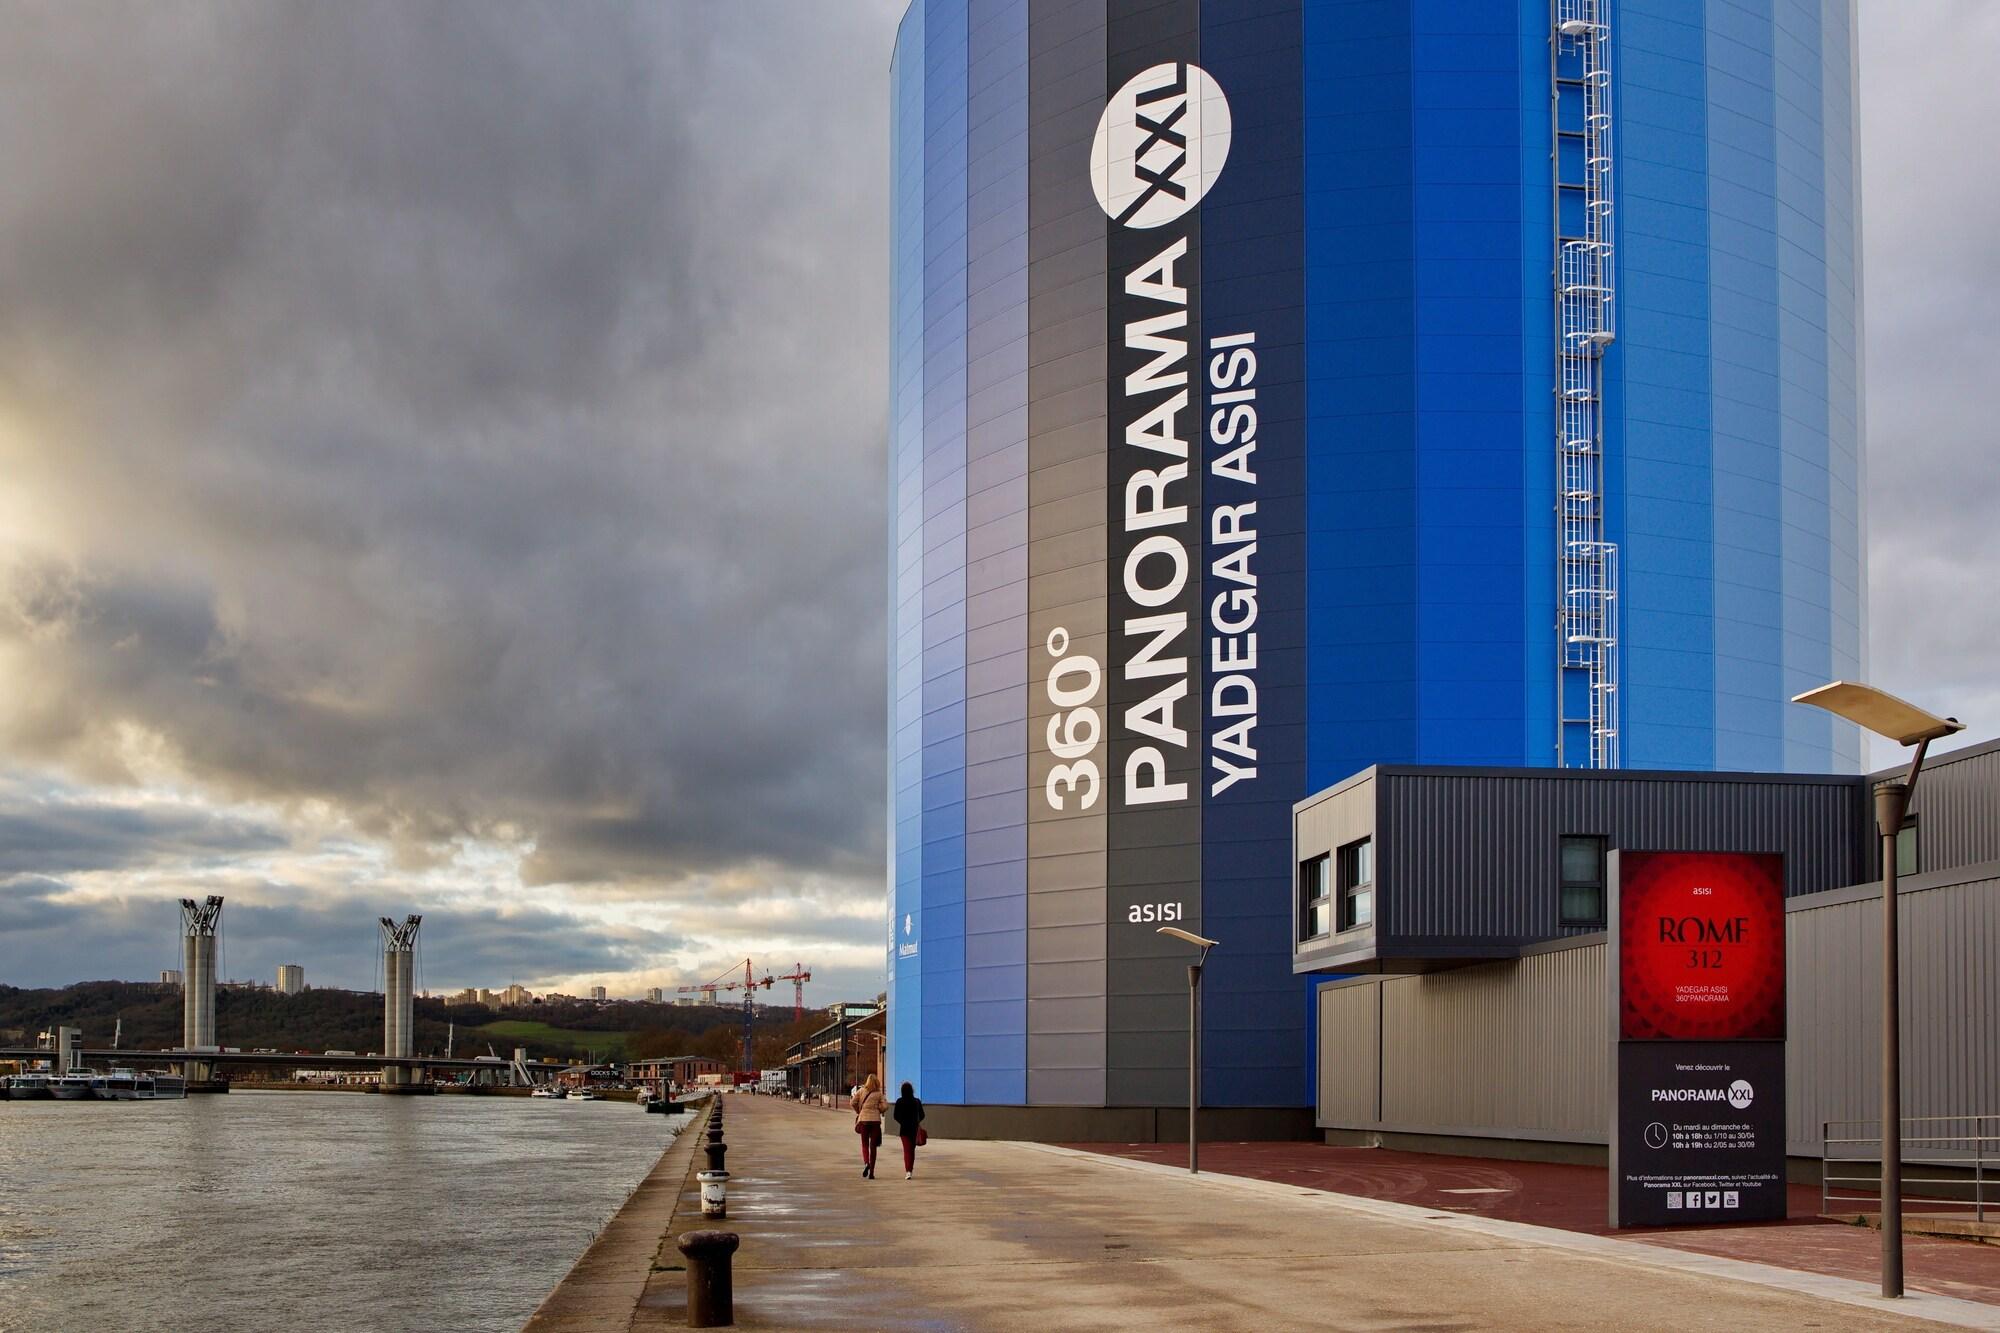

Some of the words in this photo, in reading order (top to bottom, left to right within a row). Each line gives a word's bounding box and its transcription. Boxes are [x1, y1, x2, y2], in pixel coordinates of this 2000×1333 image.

[1209, 332, 1257, 484] ASISI
[1124, 236, 1189, 806] PANORAMA
[1211, 501, 1257, 797] YADEGAR
[1046, 627, 1100, 810] 360°
[1129, 902, 1182, 922] asisi
[1687, 950, 1723, 968] 312
[1675, 985, 1709, 994] YADEGAR
[1710, 985, 1728, 994] ASISI
[1675, 1063, 1694, 1071] Venez
[1695, 1063, 1723, 1071] découvrir
[1724, 1063, 1730, 1071] le
[1651, 1089, 1727, 1101] PANORAMA
[1673, 1123, 1682, 1131] Du
[1683, 1123, 1701, 1131] mardi
[1711, 1123, 1740, 1131] dimanche
[1672, 1132, 1684, 1140] 10h
[1691, 1132, 1703, 1140] 18h
[1703, 1132, 1712, 1140] du
[1713, 1132, 1727, 1140] 1/10
[1737, 1132, 1755, 1140] 30/04
[1713, 1141, 1727, 1149] 2/05
[1737, 1141, 1755, 1149] 30/09
